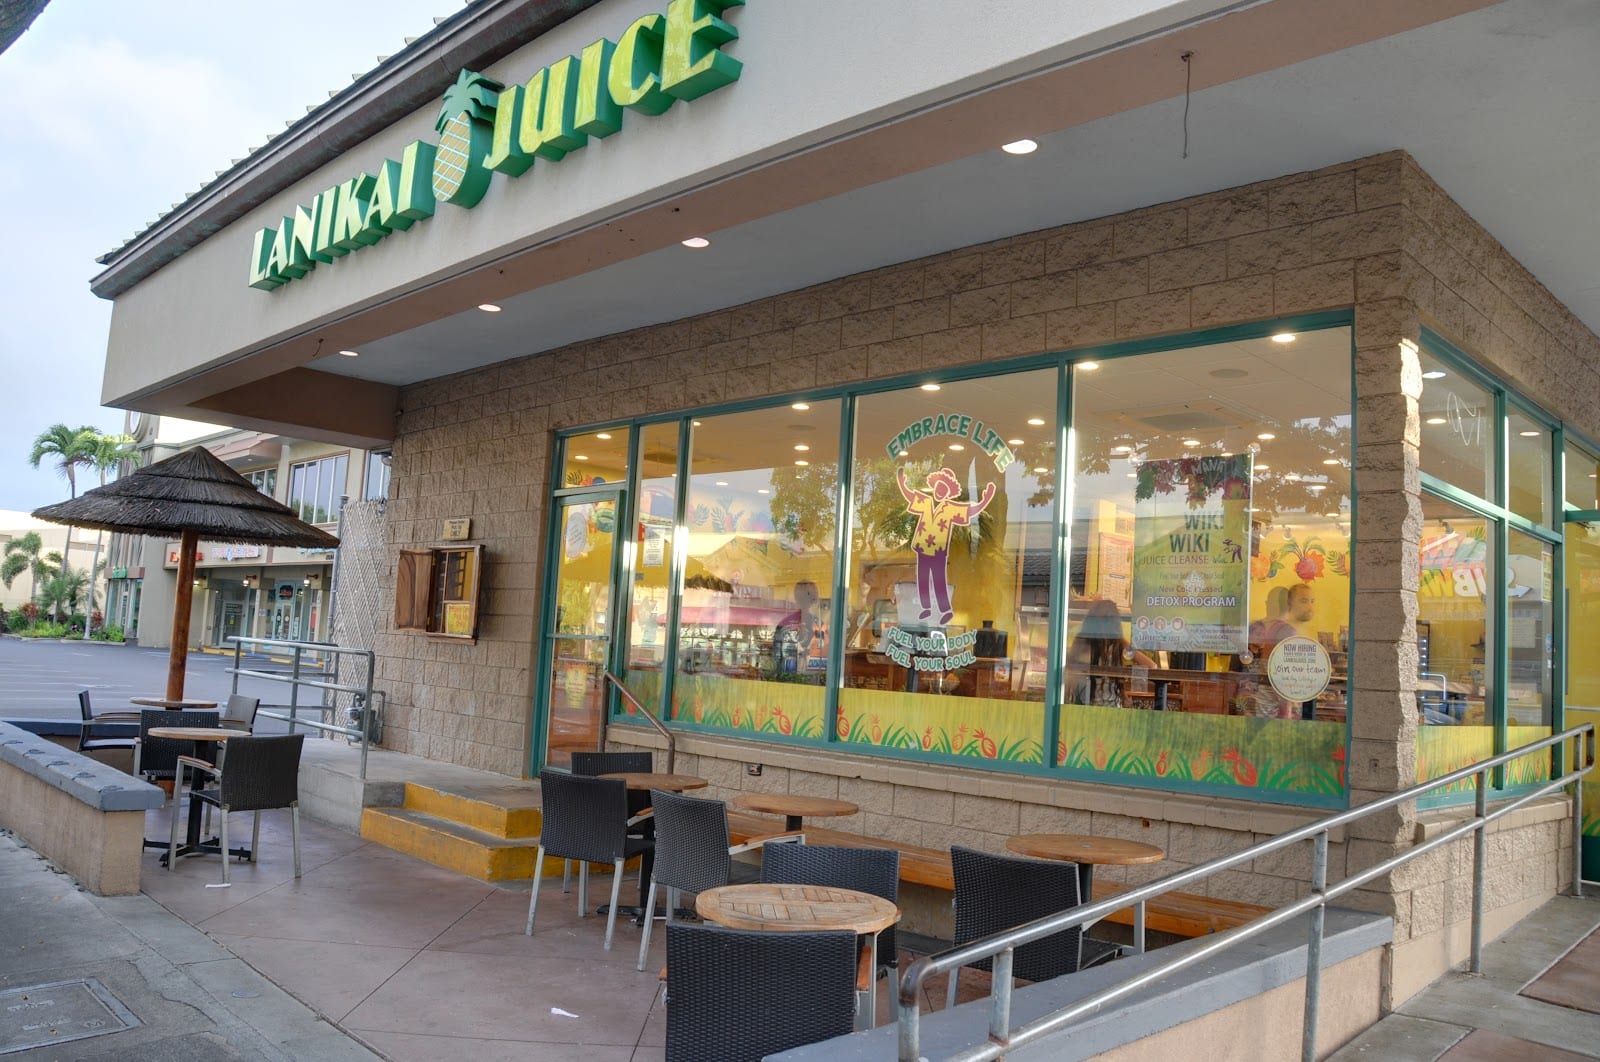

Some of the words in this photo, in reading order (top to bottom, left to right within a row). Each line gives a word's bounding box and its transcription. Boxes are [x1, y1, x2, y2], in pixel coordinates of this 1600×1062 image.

[249, 140, 434, 290] LANIKAI
[482, 0, 742, 177] JUICE
[887, 413, 972, 460] EMBRACE
[971, 421, 1015, 473] LIFE
[1169, 533, 1210, 553] WIKI
[1143, 555, 1166, 565] JUICE
[1167, 554, 1209, 565] CLEANSE
[1146, 596, 1180, 607] DETOX
[1182, 596, 1236, 607] PROGRAM
[888, 626, 914, 649] FUEL
[916, 636, 946, 653] YOUR
[947, 629, 978, 651] BODY
[1284, 644, 1296, 652] NOW
[1297, 644, 1317, 653] HIRING
[885, 643, 912, 668] FUEL
[914, 656, 944, 672] YOUR
[945, 650, 977, 670] SOUL
